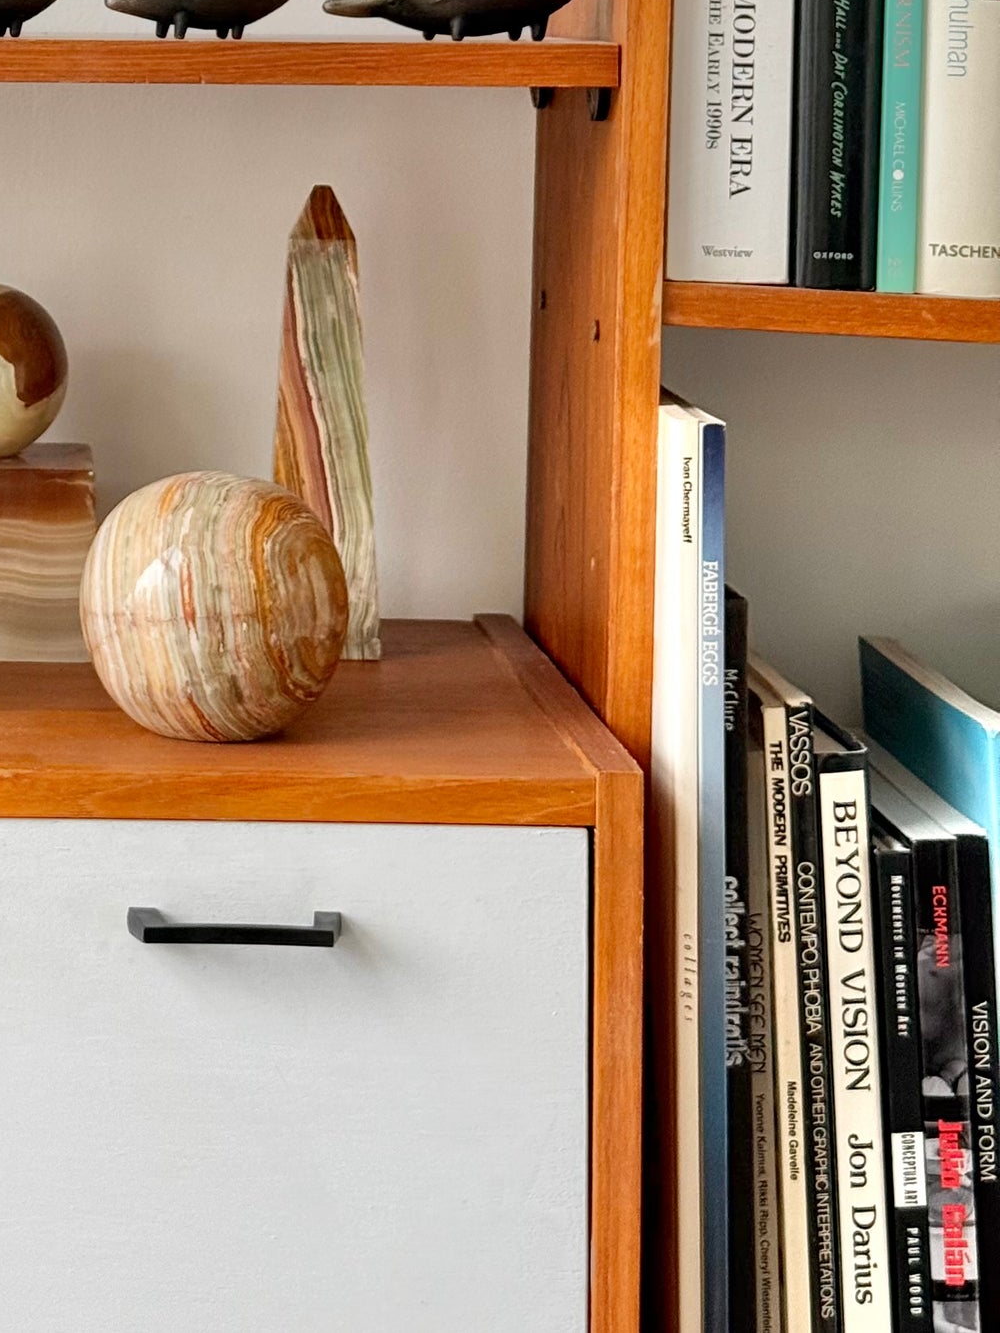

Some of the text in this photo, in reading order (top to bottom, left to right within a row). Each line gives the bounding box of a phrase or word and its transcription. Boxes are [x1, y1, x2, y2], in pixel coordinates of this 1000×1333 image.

[706, 30, 725, 94] EARLY
[832, 51, 848, 79] PAT
[705, 99, 723, 150] 1990s
[830, 81, 848, 167] CORRINGTON
[892, 100, 906, 162] MICHAEL
[729, 134, 753, 200] ERA
[828, 169, 846, 218] WYKES
[701, 245, 754, 258] Westview
[813, 251, 854, 260] OXFORD
[929, 243, 1000, 258] TASCHEN
[682, 456, 692, 544] Ivan Chermayeff
[702, 560, 721, 686] FABERGÉ EGGS
[789, 711, 813, 796] VASSOS
[769, 740, 791, 944] THE MODERN PRIMITIVES
[724, 875, 746, 949] collect
[932, 885, 950, 969] ECKMANN
[680, 933, 696, 1022] collages
[890, 875, 910, 1037] MOVEMENTS IN MODERN ART
[749, 913, 767, 1074] WOMEN SEE MEN
[802, 968, 822, 1035] PHOBIA
[809, 1043, 824, 1074] AND
[833, 800, 879, 1306] BEYOND VISION Jon Darius
[755, 1093, 765, 1133] Yvonne
[810, 1076, 826, 1125] OTHER
[972, 1000, 997, 1182] VISION AND FORM
[787, 1081, 799, 1181] Madeleine Gavelle
[812, 1127, 829, 1191] GRAPHIC
[938, 1119, 964, 1188] Julio
[901, 1133, 918, 1205] CONCEPTUAL ART
[816, 1193, 835, 1318] INTERPRETATIONS
[906, 1226, 923, 1317] PAUL WOOD
[942, 1203, 970, 1286] Galán
